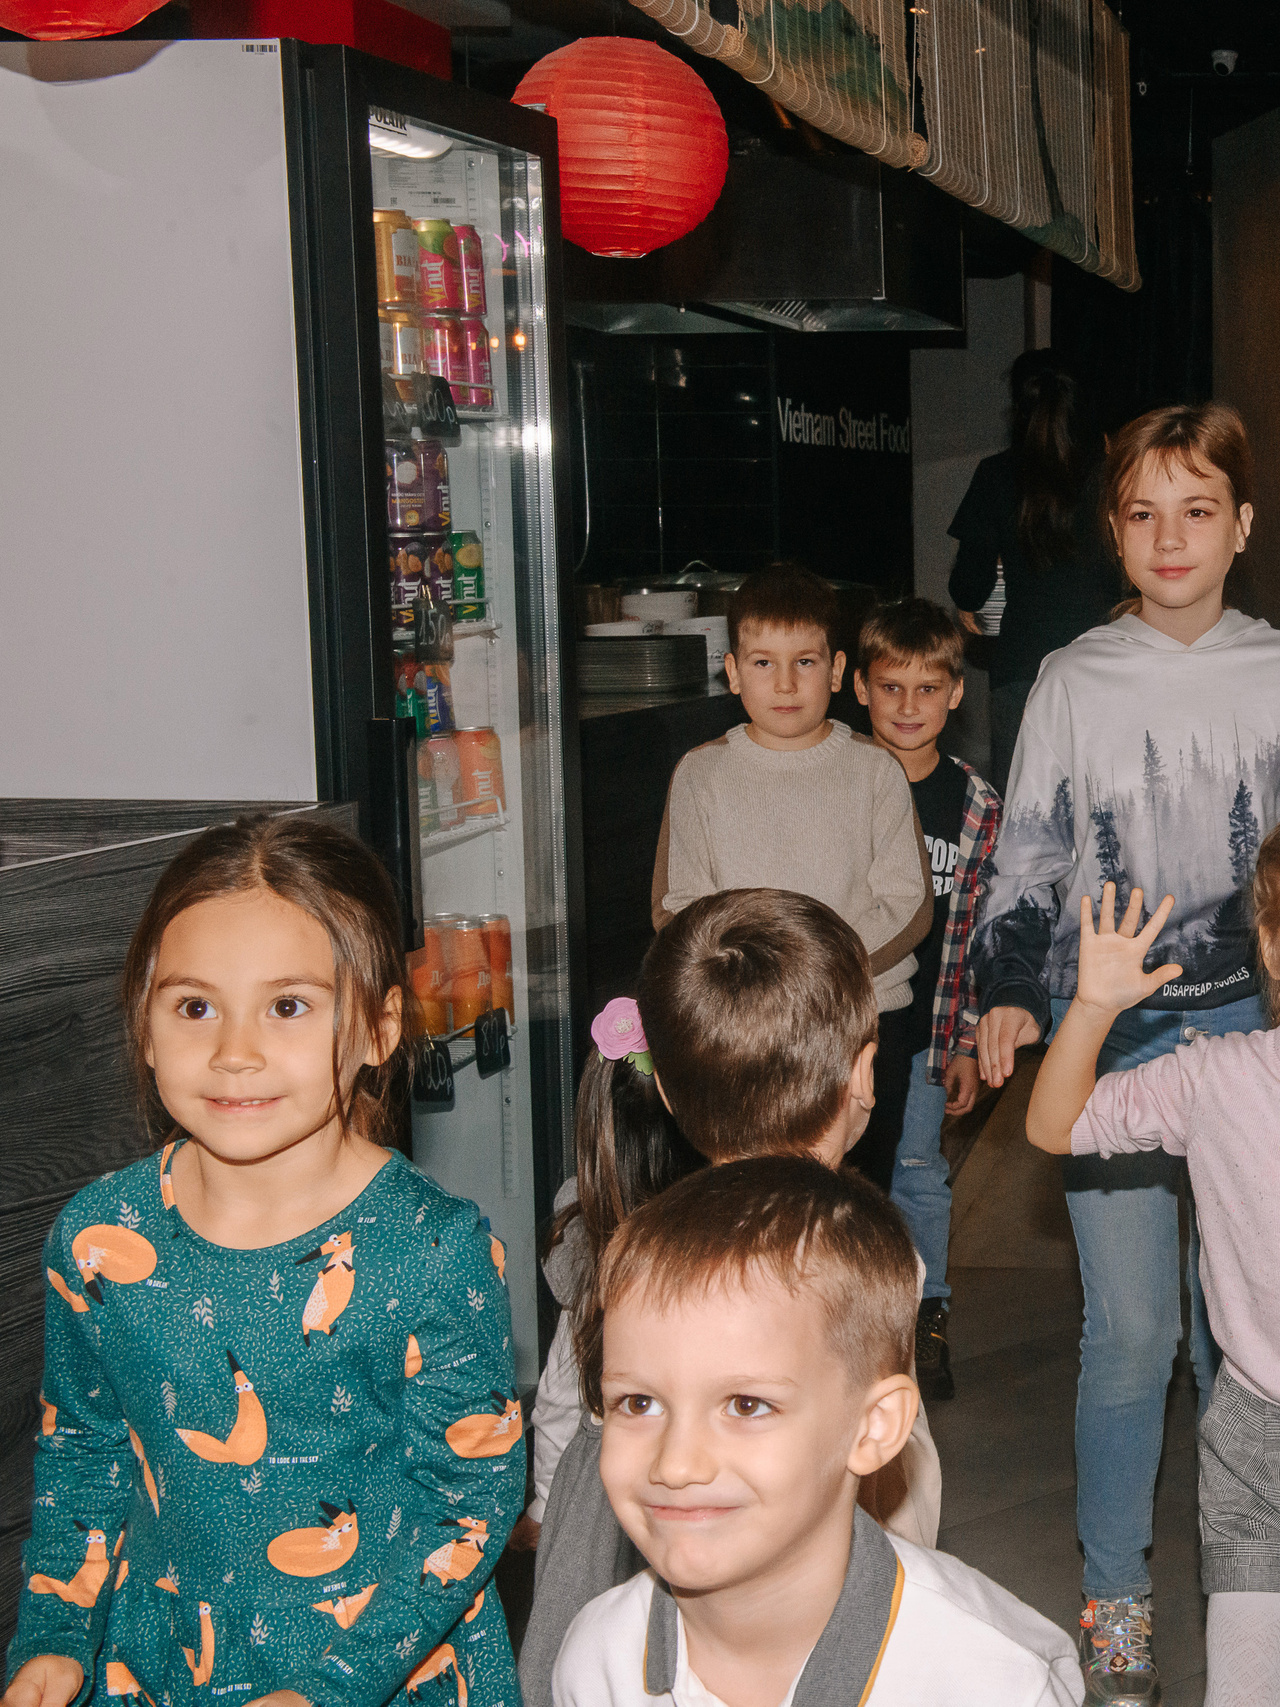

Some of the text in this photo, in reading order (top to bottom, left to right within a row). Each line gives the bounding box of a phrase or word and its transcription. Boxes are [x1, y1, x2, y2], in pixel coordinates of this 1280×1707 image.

[776, 396, 911, 454] Vietnam Street Food
